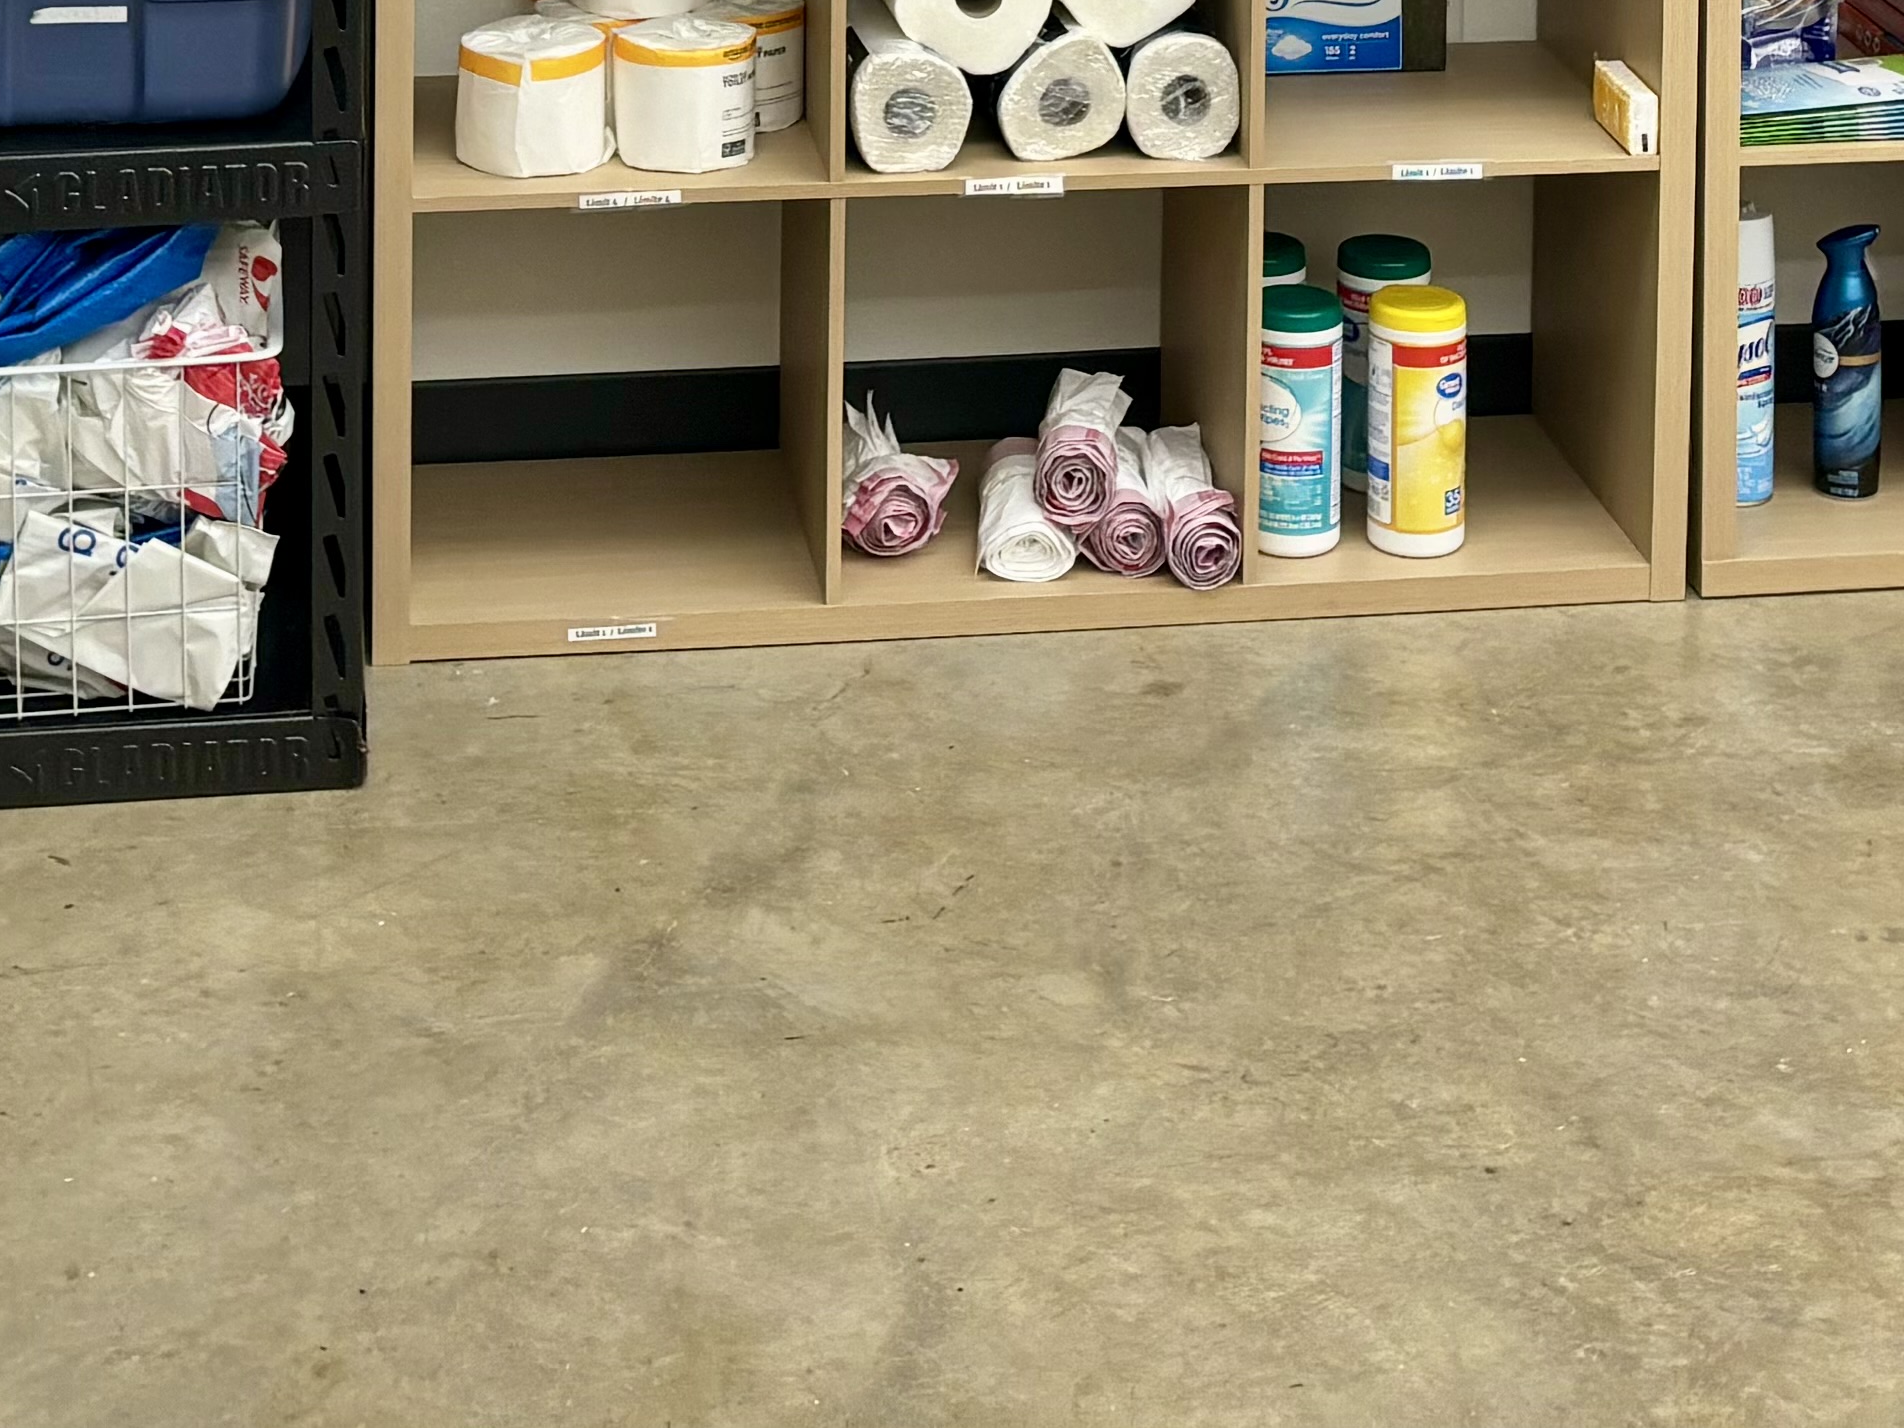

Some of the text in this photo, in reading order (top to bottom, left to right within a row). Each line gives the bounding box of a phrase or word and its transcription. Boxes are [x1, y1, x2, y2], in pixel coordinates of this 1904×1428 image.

[1322, 33, 1358, 42] everyday
[59, 161, 310, 213] GLADIATOR
[238, 245, 250, 304] SAFEWAY
[1446, 489, 1461, 506] 35
